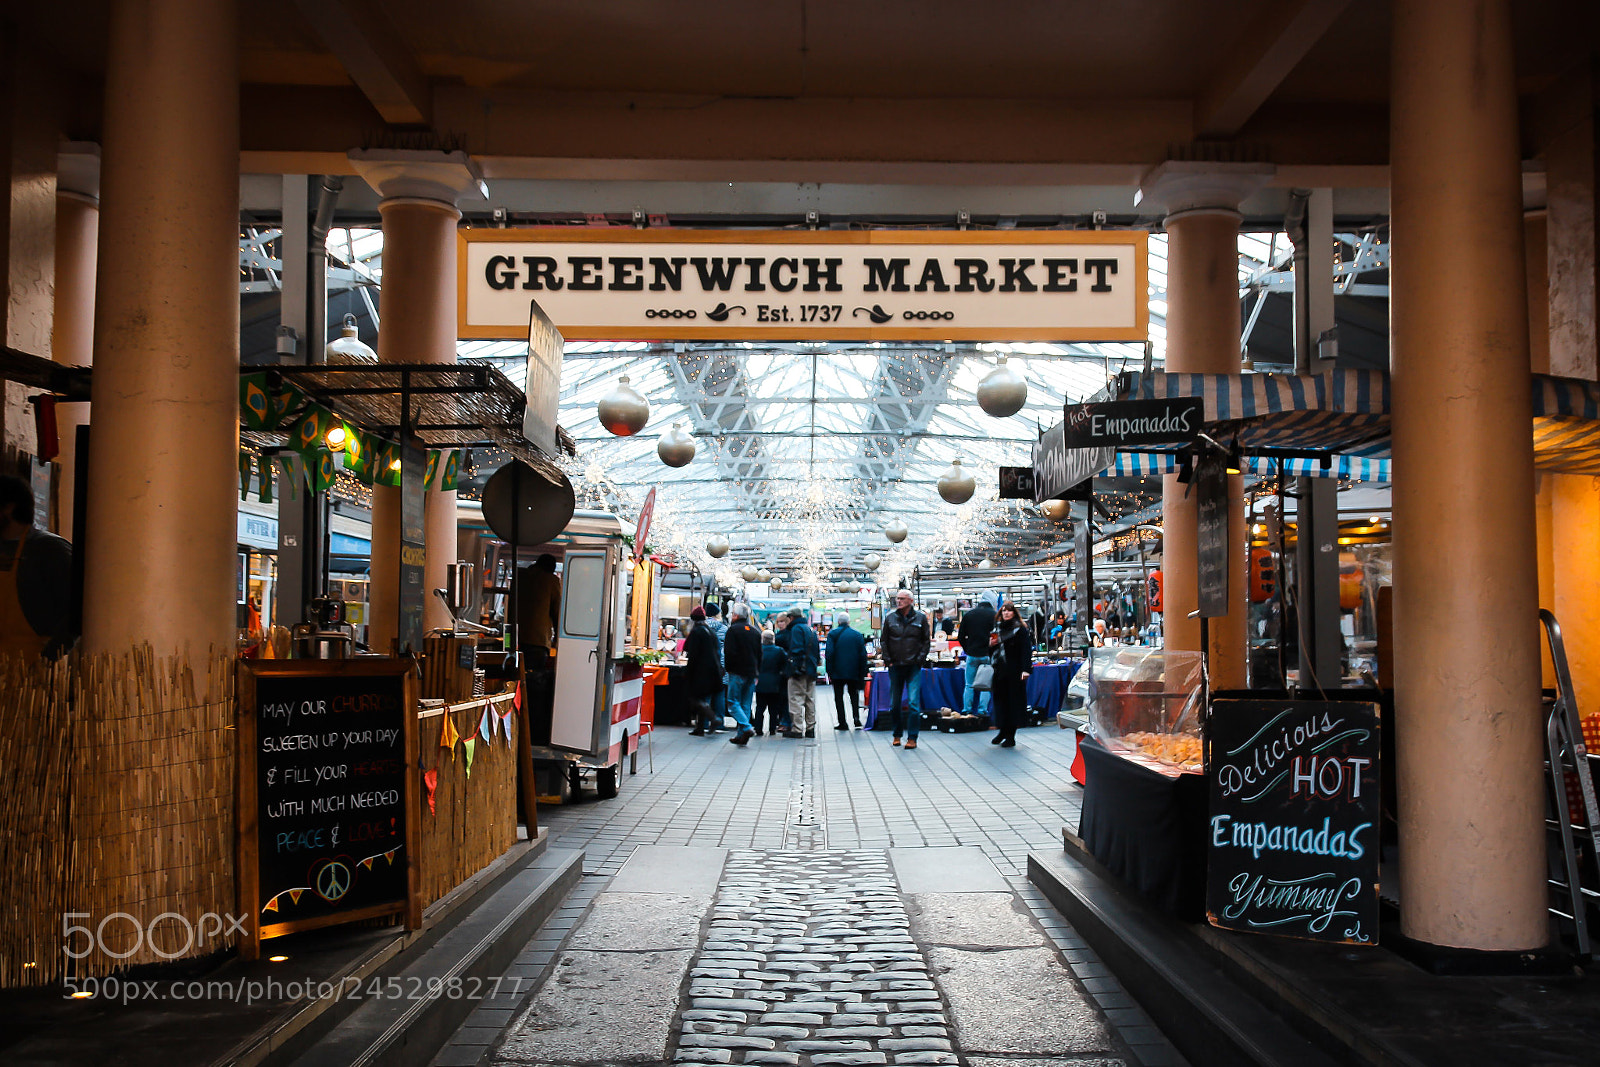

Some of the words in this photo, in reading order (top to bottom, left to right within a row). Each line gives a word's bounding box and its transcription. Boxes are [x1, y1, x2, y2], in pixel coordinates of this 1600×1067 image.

[485, 255, 843, 292] GREENWICH
[863, 257, 1118, 293] MARKET
[756, 304, 794, 322] Est.
[800, 304, 843, 322] 1737
[1069, 403, 1092, 427] hot
[1091, 405, 1196, 441] Empanadas
[262, 700, 295, 727] MAY
[300, 699, 327, 716] OUR
[262, 733, 319, 753] SWEETEN
[322, 731, 339, 747] UP
[342, 729, 373, 750] YOUR
[375, 728, 400, 748] DAY
[1218, 711, 1345, 797] Delicious
[314, 764, 348, 786] YOUR
[1290, 755, 1372, 800] HOT
[311, 794, 346, 815] MUCH
[350, 789, 400, 810] NEEDED
[276, 827, 326, 853] PEACE
[1210, 813, 1373, 861] Empanadas
[1222, 871, 1362, 934] Yummy
